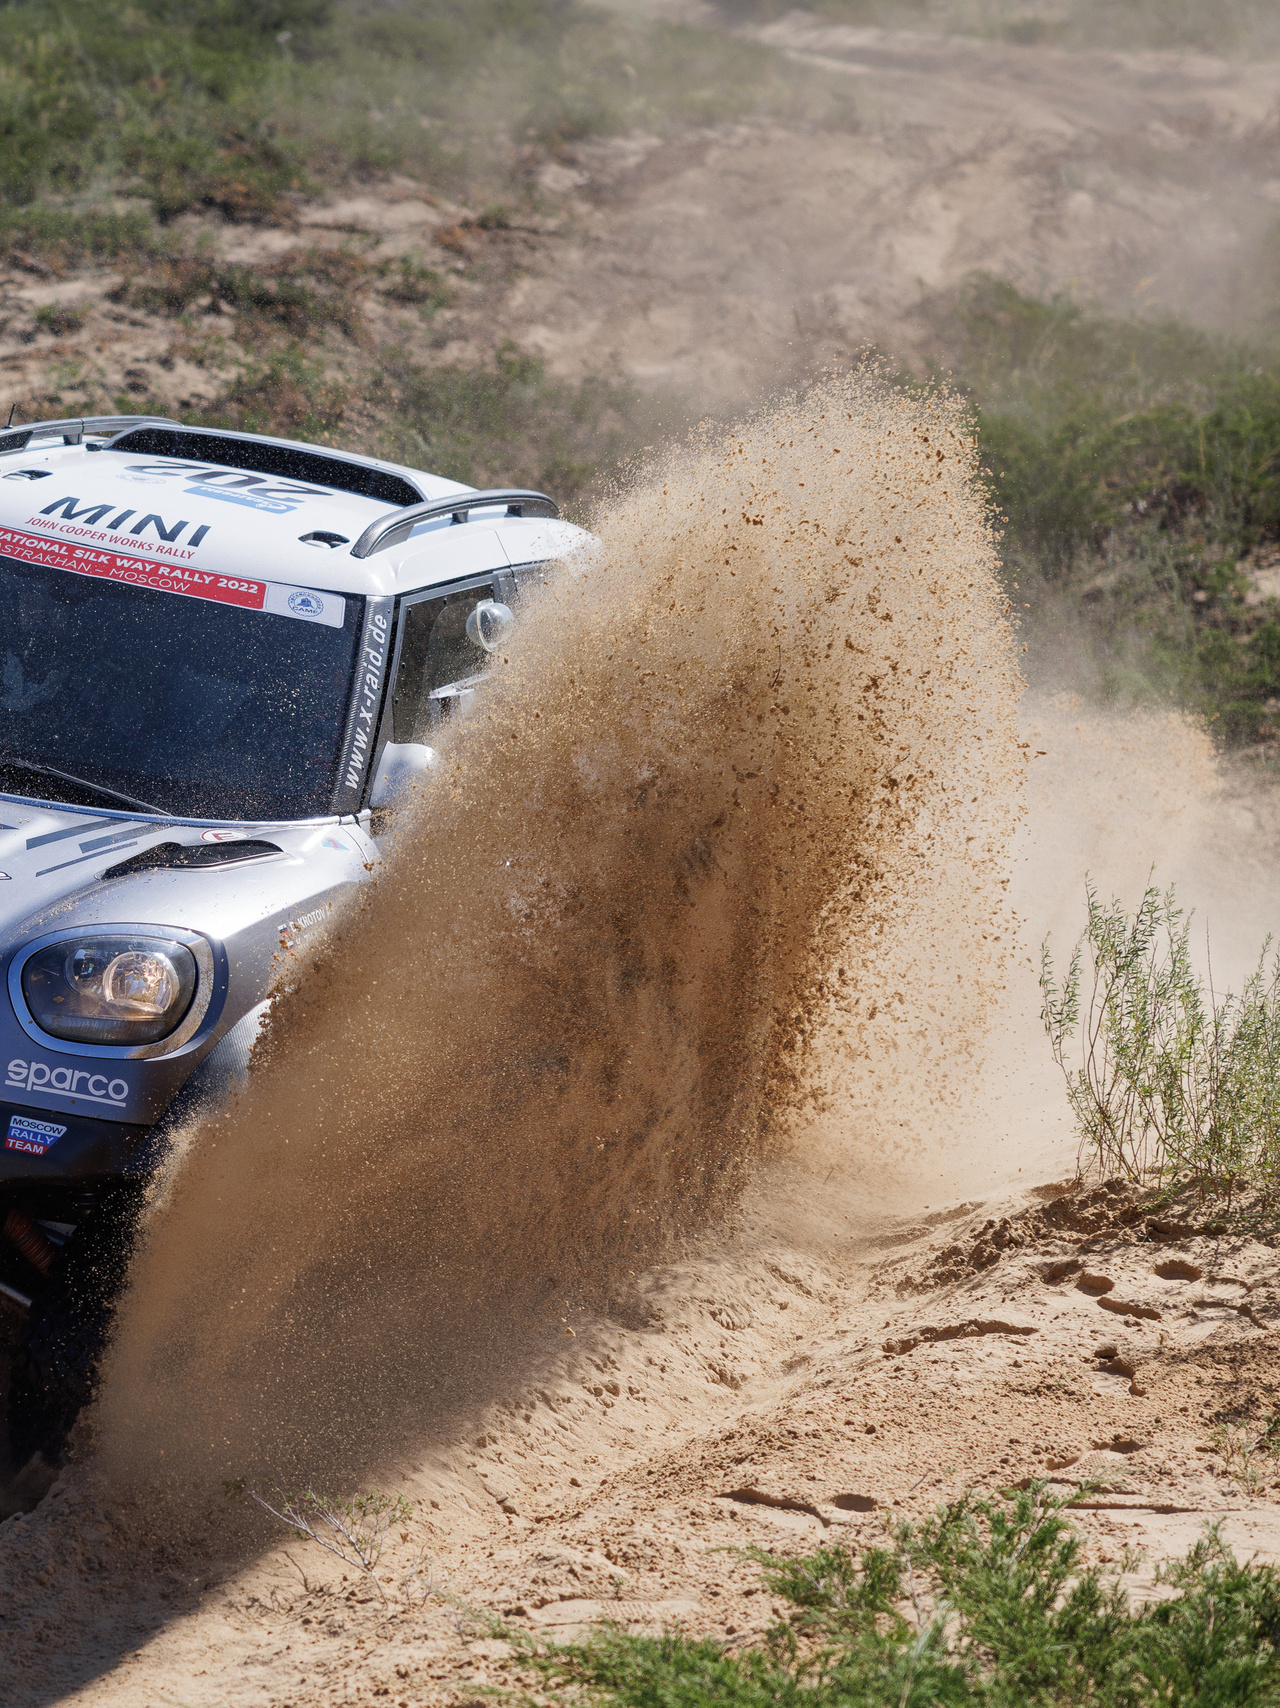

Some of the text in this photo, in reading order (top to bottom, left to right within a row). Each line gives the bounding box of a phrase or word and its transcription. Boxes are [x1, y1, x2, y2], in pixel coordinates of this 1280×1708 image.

[124, 460, 334, 503] 202
[24, 516, 195, 560] JOHN COOPER WORKS RALLY
[38, 496, 212, 548] MINI
[73, 548, 110, 565] SILK
[115, 558, 157, 573] WAY
[158, 566, 215, 585] RALLY
[217, 577, 259, 594] 2022
[109, 568, 191, 592] MOSCOW
[345, 613, 388, 790] www.x-raid.de
[6, 1059, 129, 1101] sparco
[7, 1138, 44, 1154] TEAM
[10, 1128, 55, 1145] RALLY
[11, 1118, 64, 1135] MOSCOW
